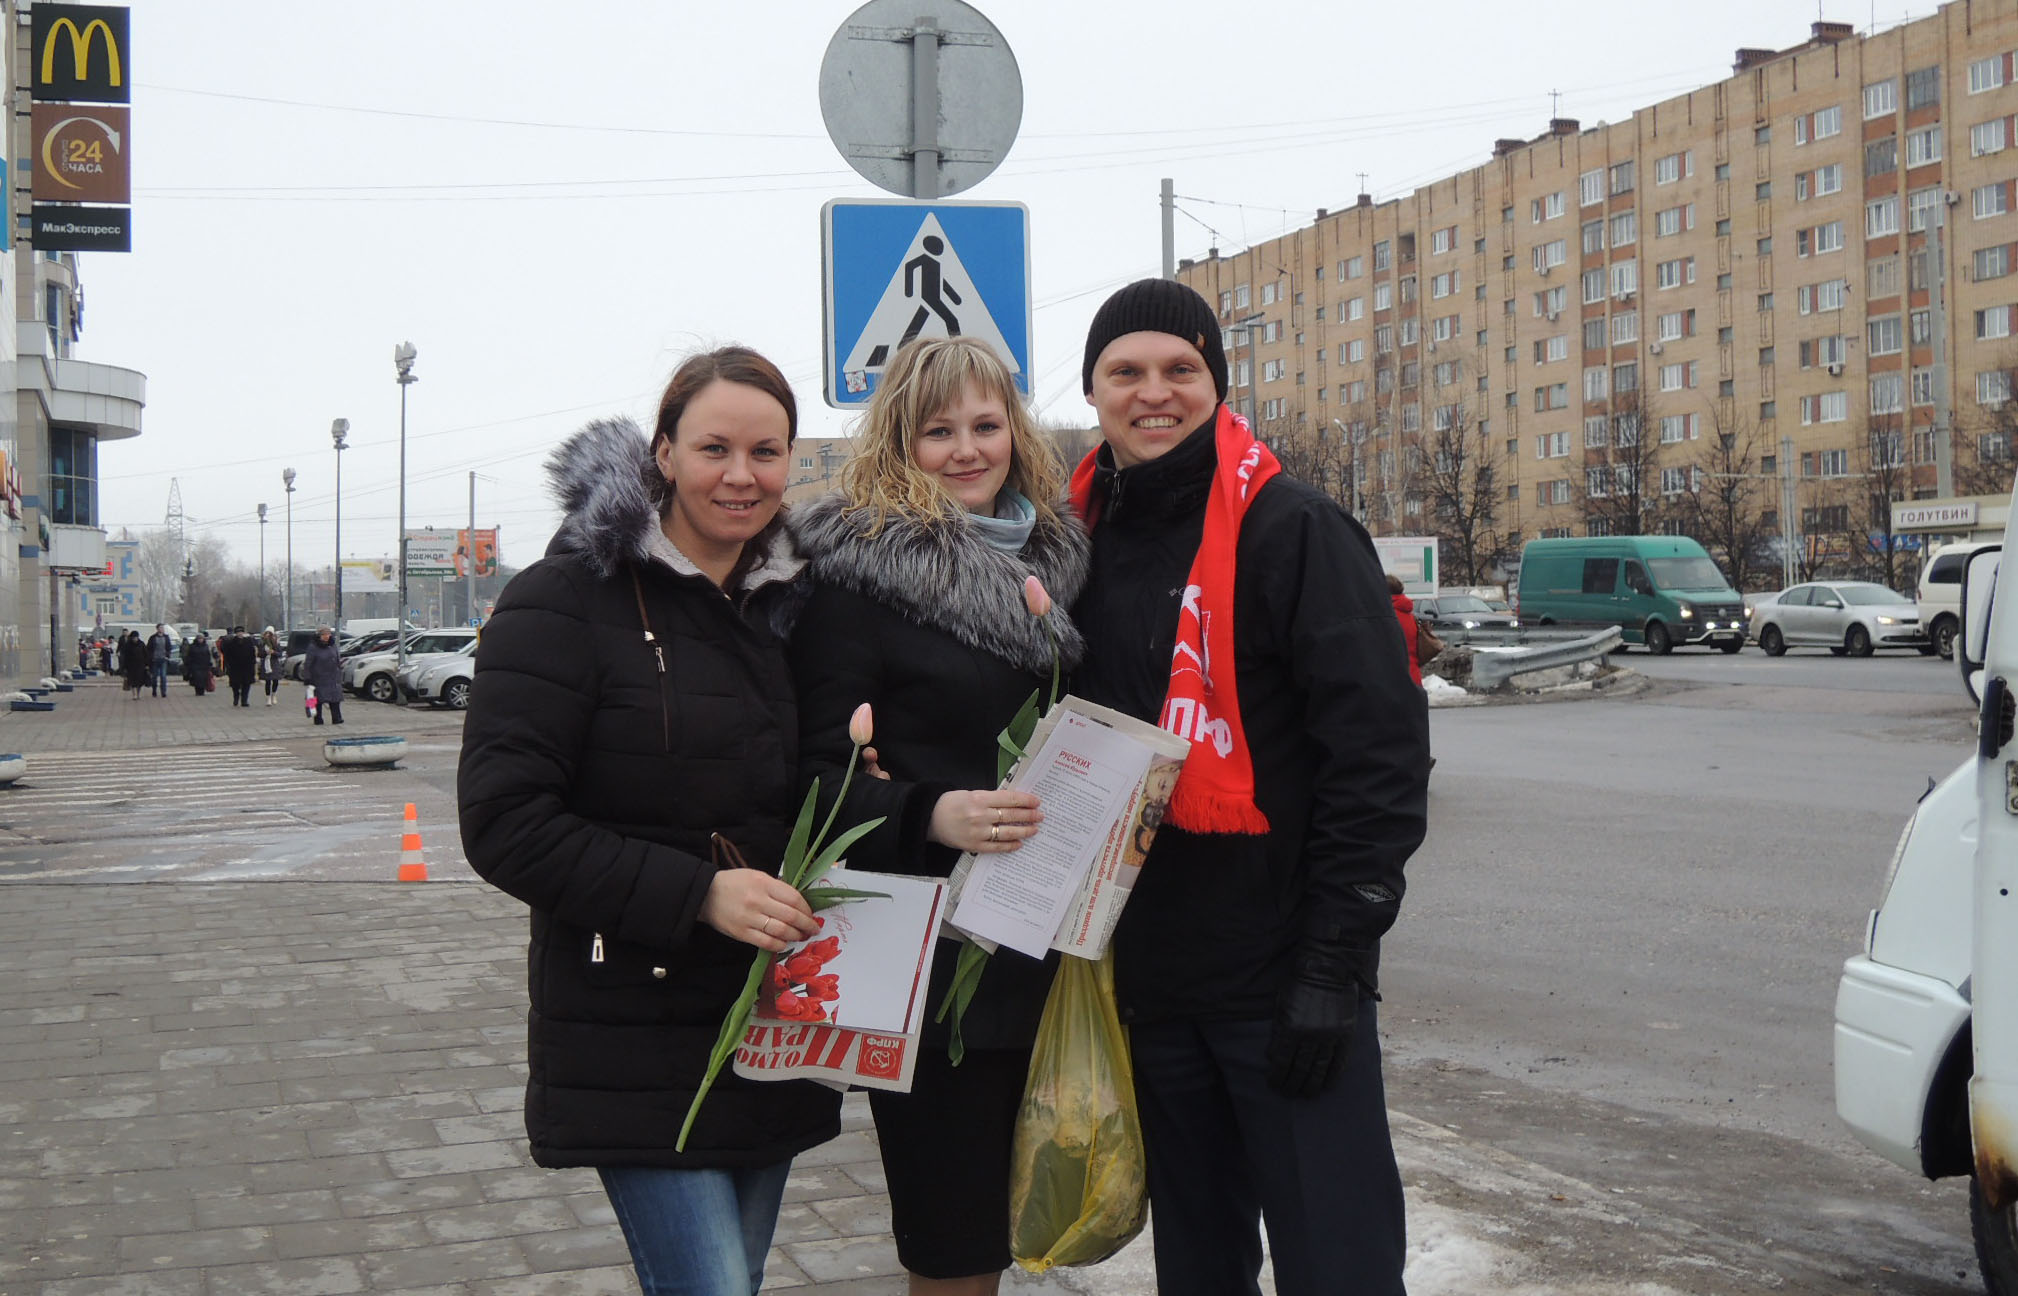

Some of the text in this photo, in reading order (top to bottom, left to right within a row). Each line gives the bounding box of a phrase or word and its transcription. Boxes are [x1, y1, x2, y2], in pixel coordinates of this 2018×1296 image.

[69, 140, 103, 162] 24
[69, 163, 103, 173] ЧАСА
[42, 223, 121, 235] МакЭкспресс
[1901, 507, 1969, 523] ГОЛУТВИН
[1161, 698, 1233, 758] ПРФ
[1059, 751, 1092, 769] РУССКИХ
[1096, 845, 1111, 878] протеста
[1091, 878, 1101, 895] день
[1087, 895, 1096, 910] или
[1075, 910, 1092, 946] Праздник
[866, 1037, 900, 1049] КПРФ
